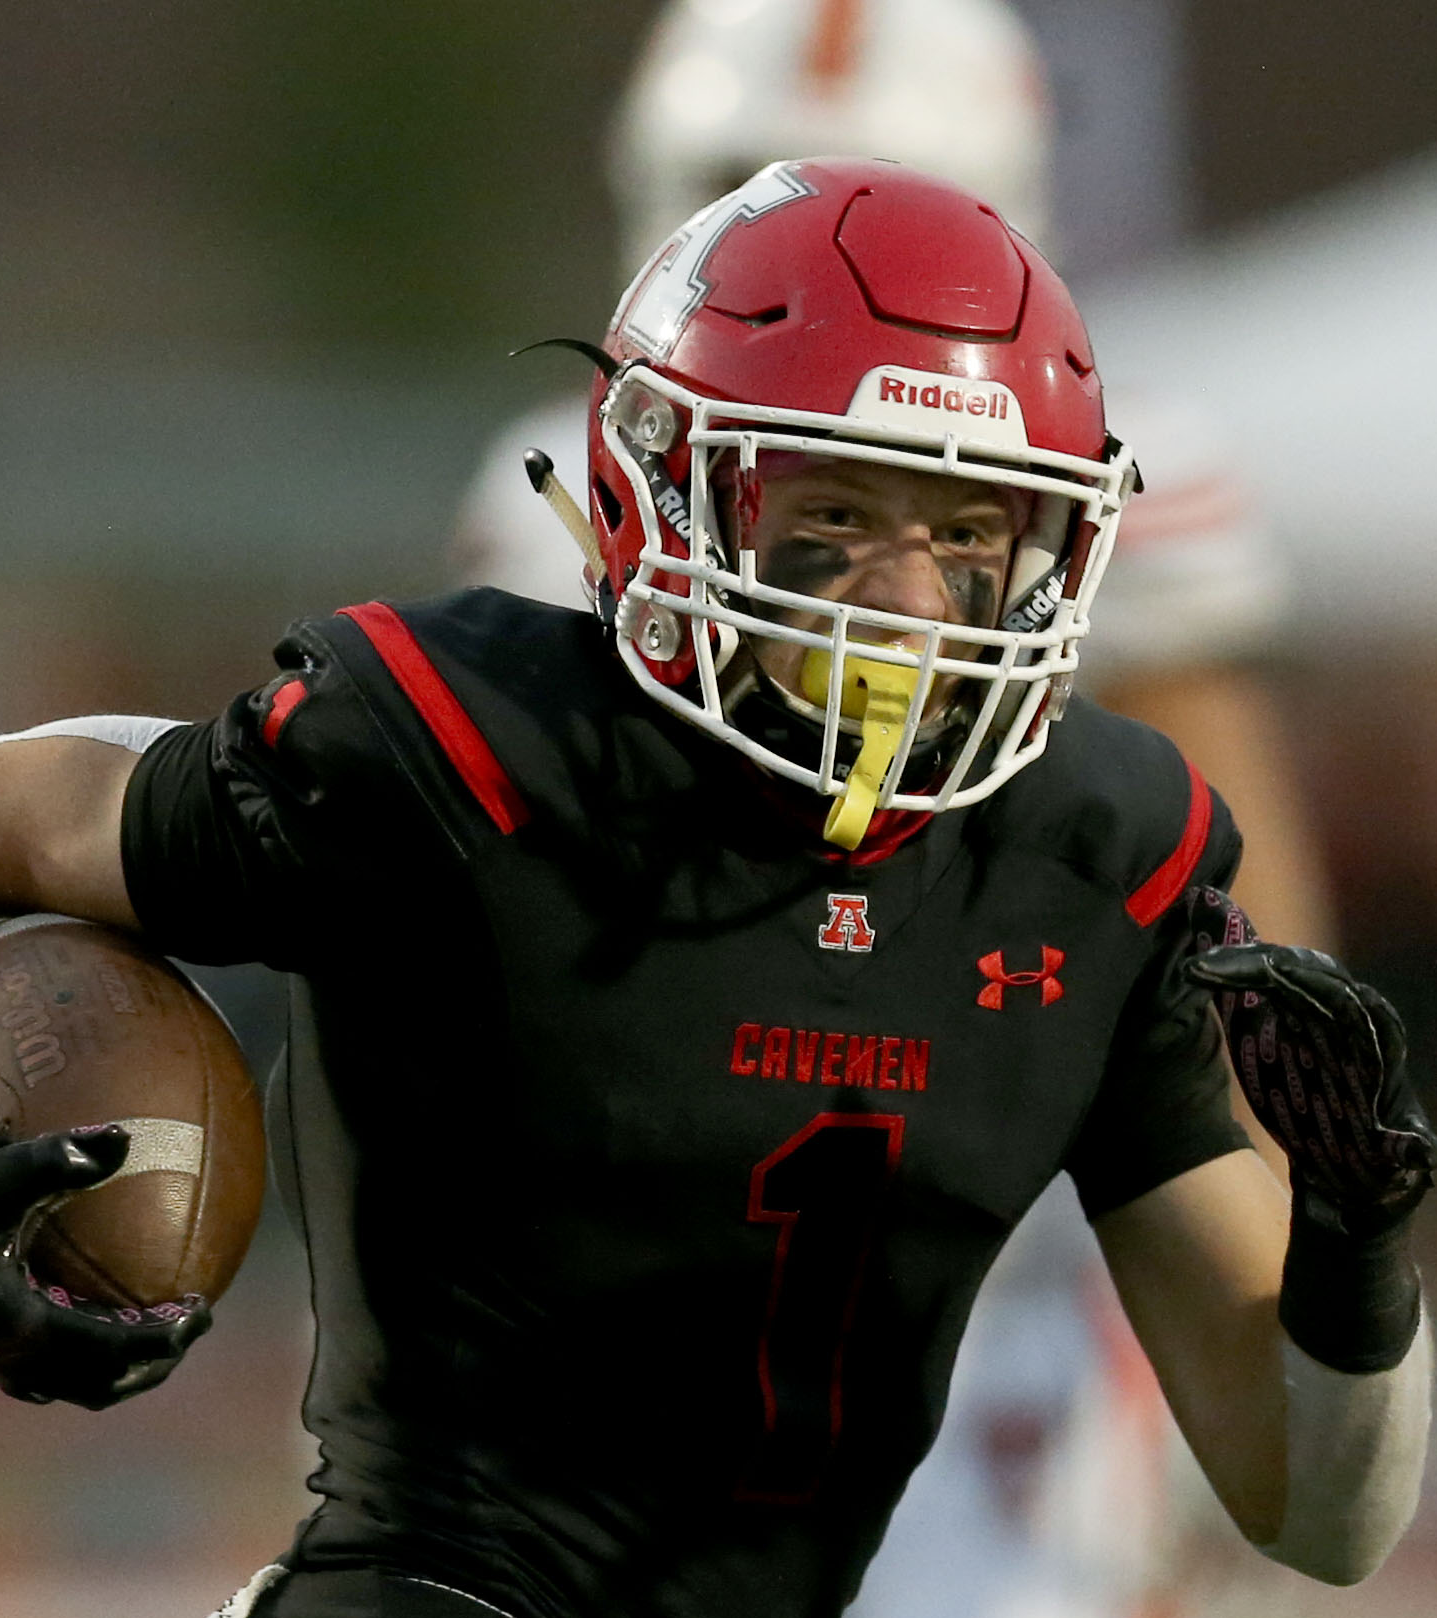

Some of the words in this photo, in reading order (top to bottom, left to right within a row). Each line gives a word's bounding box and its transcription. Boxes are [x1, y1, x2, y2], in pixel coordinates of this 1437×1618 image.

[879, 376, 1009, 420] Riddell
[818, 893, 876, 952] A
[730, 1021, 931, 1092] CAVEMEN
